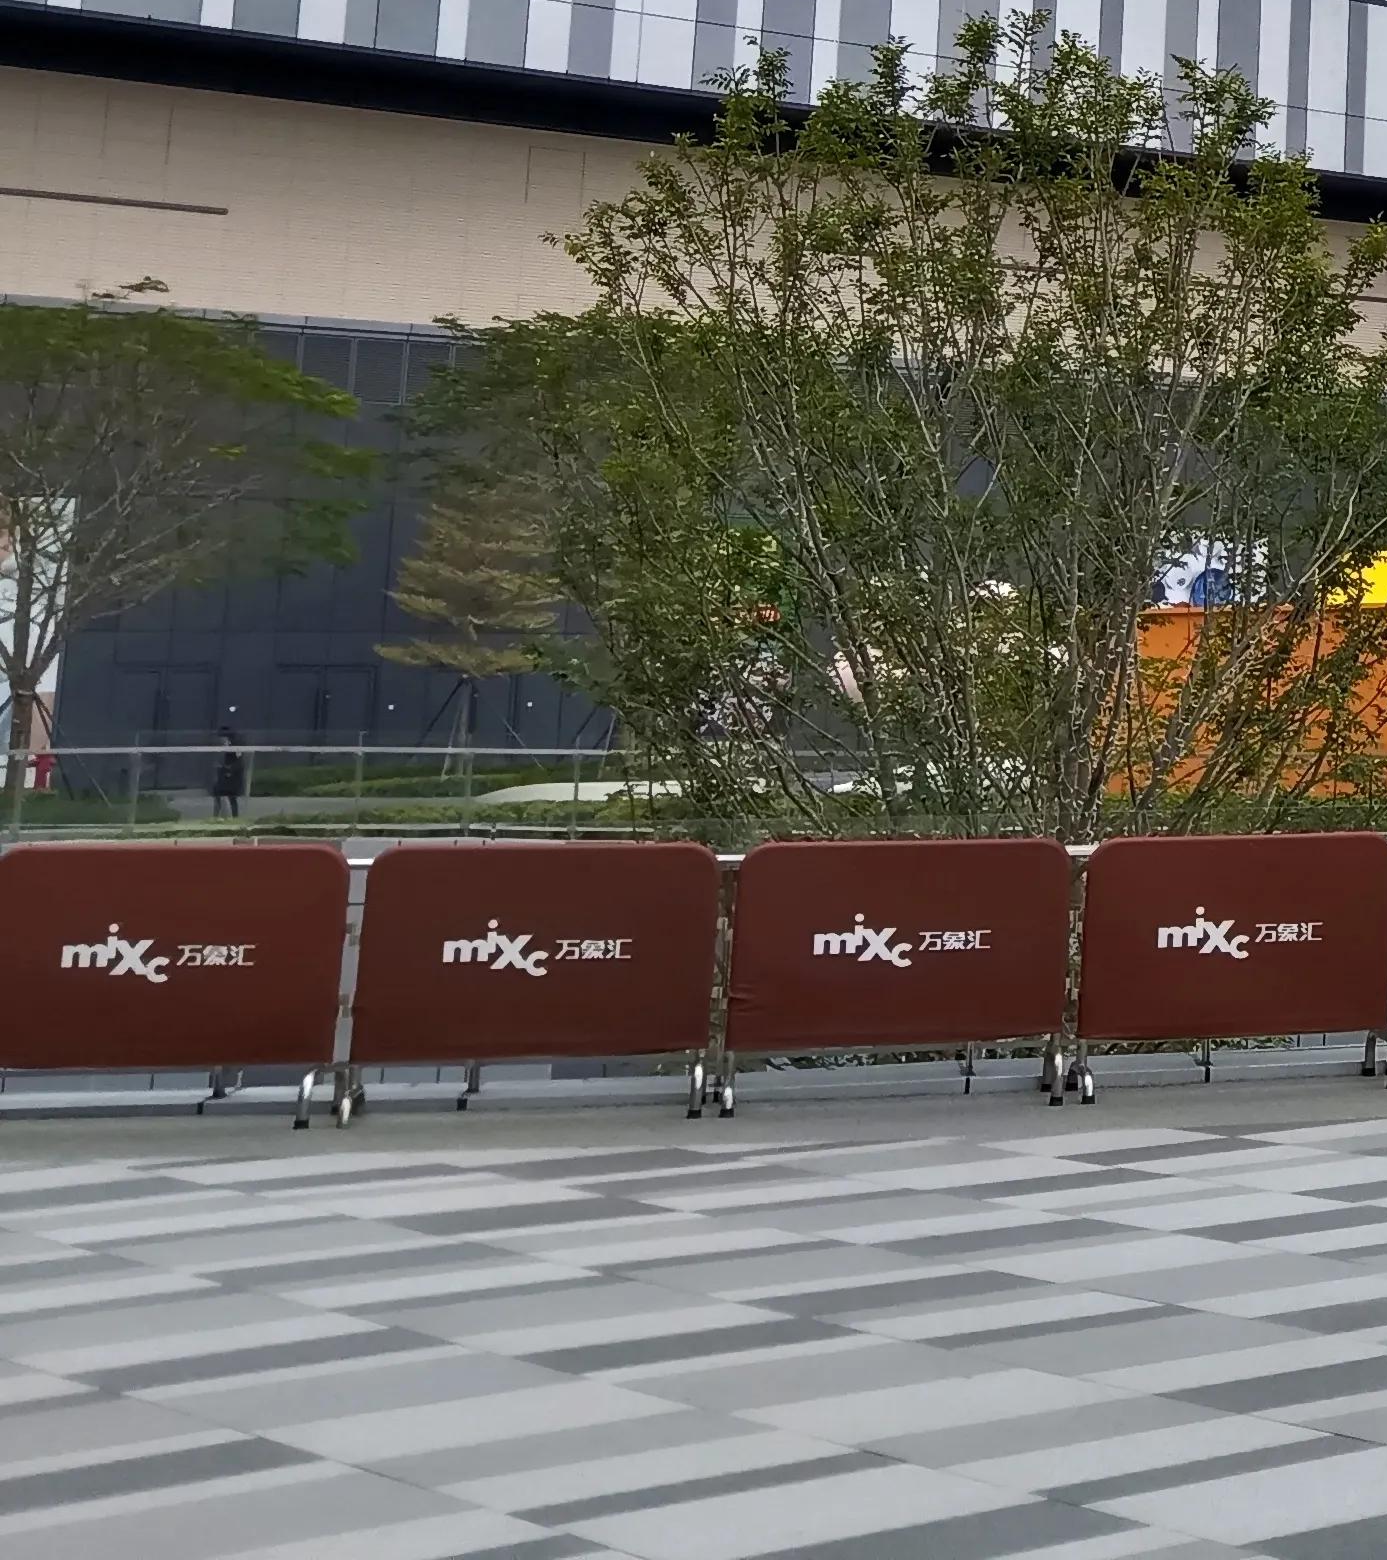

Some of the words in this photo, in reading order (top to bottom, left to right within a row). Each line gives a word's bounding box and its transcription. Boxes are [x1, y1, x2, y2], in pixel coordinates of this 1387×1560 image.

[918, 929, 992, 951] 万象汇
[1254, 921, 1324, 943] 万象汇
[176, 943, 256, 967] 万象汇
[554, 938, 633, 961] 万象汇
